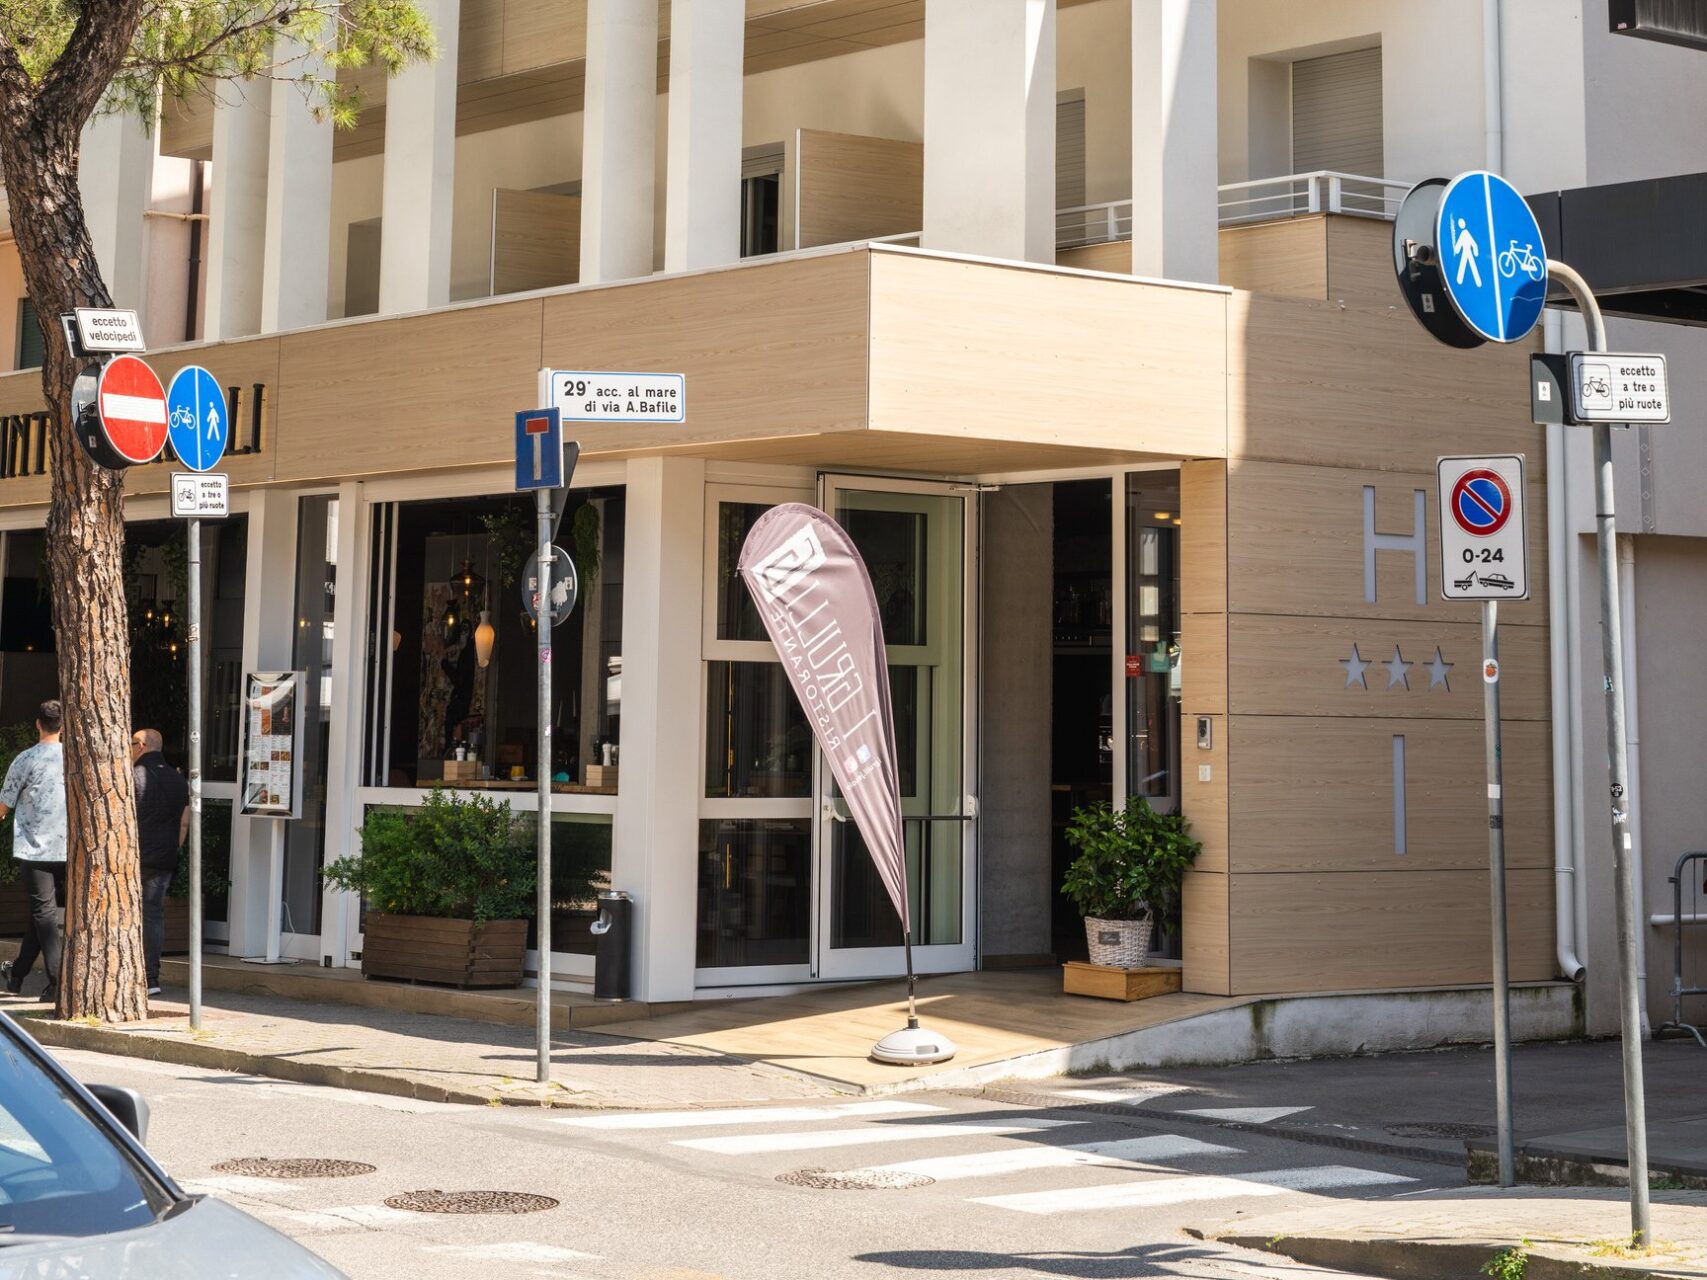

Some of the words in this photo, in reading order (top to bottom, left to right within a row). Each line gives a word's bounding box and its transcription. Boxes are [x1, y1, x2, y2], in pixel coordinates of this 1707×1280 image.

[92, 317, 127, 327] eccetto
[89, 330, 136, 343] velocipedi
[1620, 365, 1656, 376] eccetto
[596, 387, 622, 397] acc.
[628, 386, 640, 397] al
[645, 388, 677, 398] mare
[1623, 383, 1629, 392] a
[1633, 381, 1647, 392] tre
[1649, 384, 1656, 392] o
[585, 401, 596, 412] di
[602, 401, 620, 412] via
[626, 401, 677, 413] A.Bafile
[1619, 397, 1634, 411] più
[1637, 398, 1662, 409] ruote
[1363, 485, 1428, 606] H
[1462, 548, 1504, 564] 0-24
